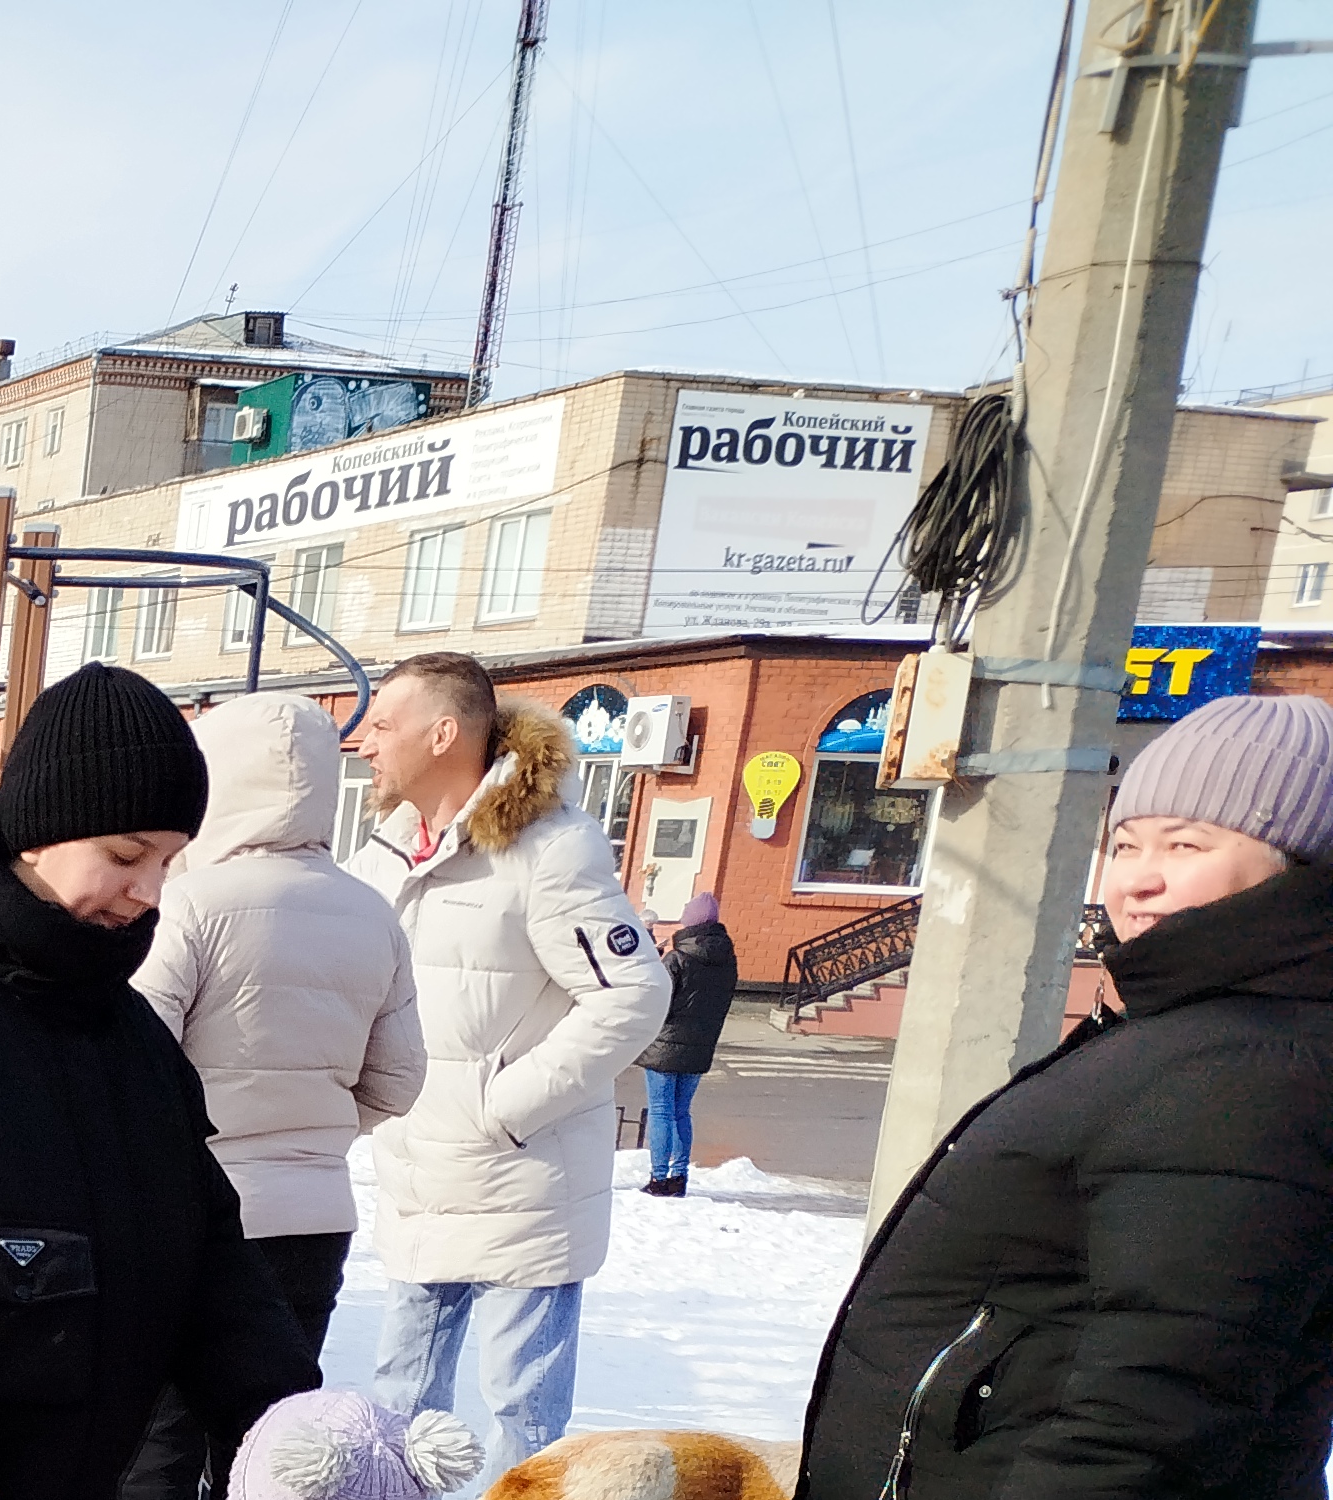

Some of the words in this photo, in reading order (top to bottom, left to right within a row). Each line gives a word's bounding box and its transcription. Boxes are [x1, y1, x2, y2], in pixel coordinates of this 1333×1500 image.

[782, 411, 886, 432] Копейский
[331, 436, 425, 474] Копейский
[673, 416, 917, 472] рабочий
[225, 437, 457, 547] рабочий
[722, 547, 845, 575] kr-gazeta.ru
